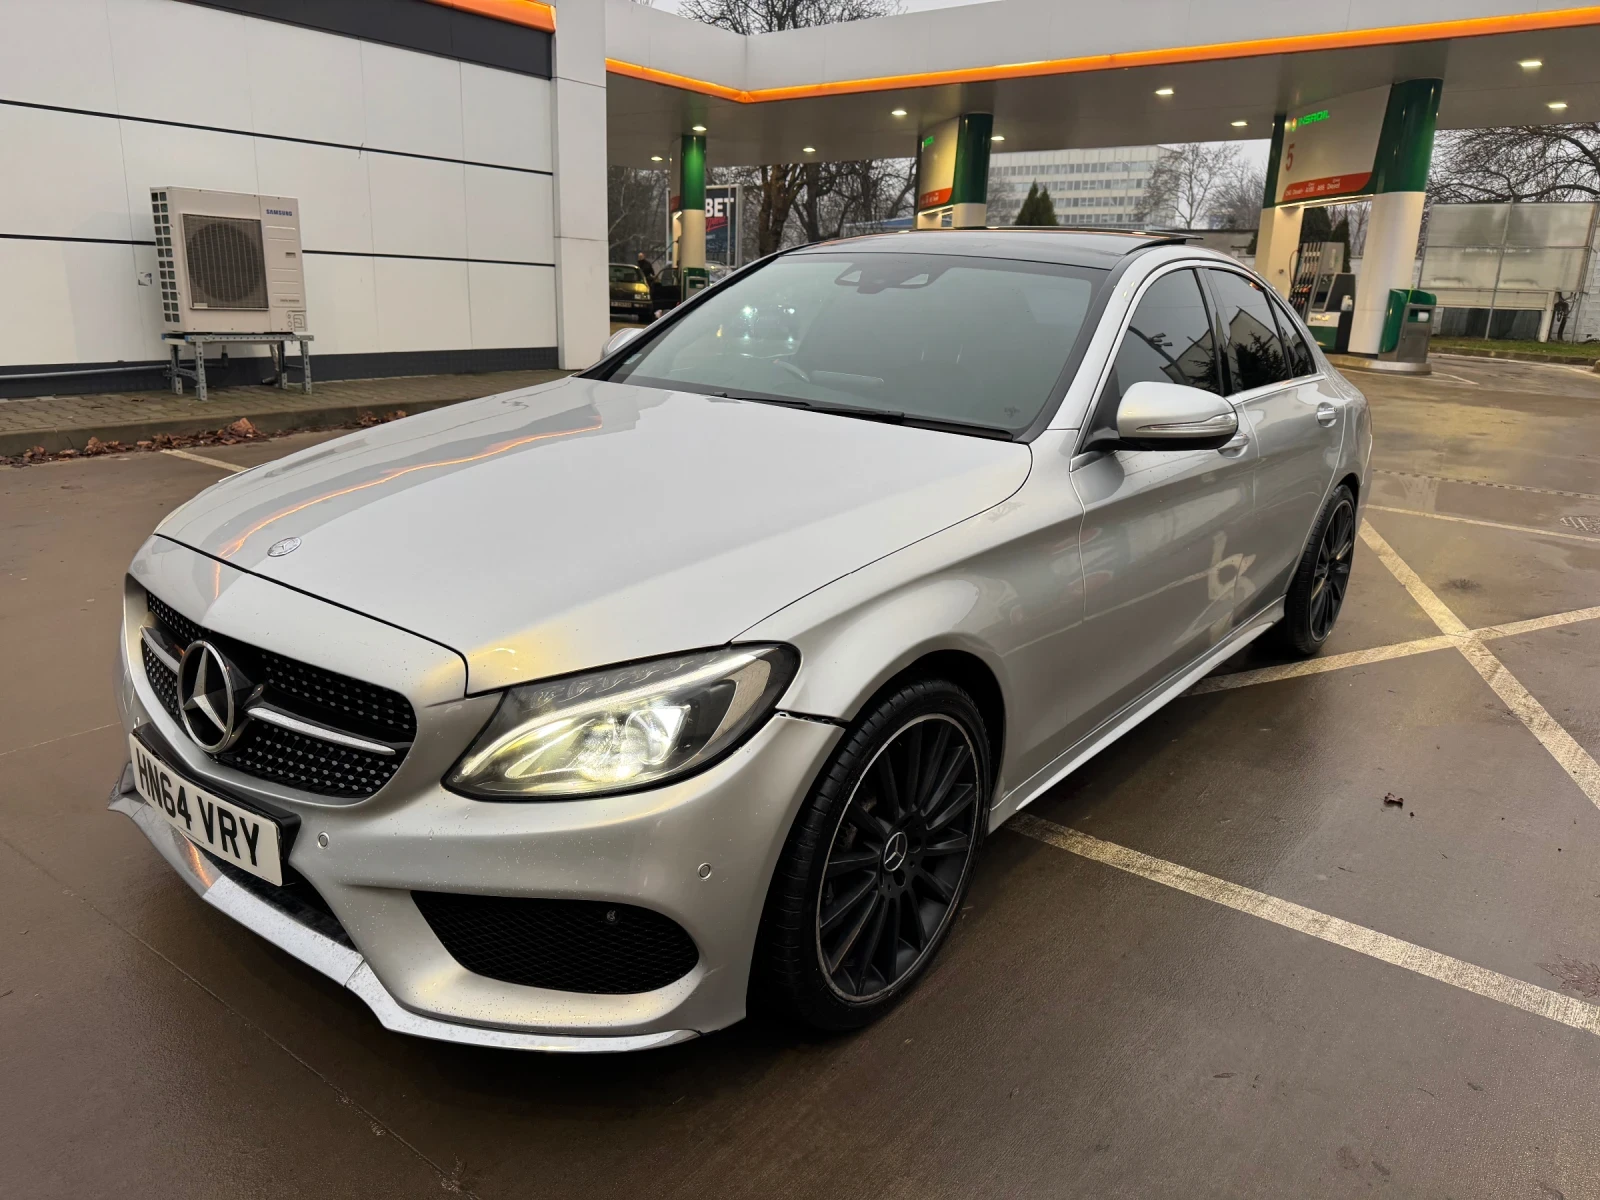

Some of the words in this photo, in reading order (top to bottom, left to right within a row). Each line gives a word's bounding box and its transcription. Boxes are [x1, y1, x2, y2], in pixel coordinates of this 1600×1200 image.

[1285, 143, 1295, 171] 5
[266, 208, 292, 216] SAMSUNG
[135, 747, 192, 831] HN64
[197, 795, 260, 867] VRY
